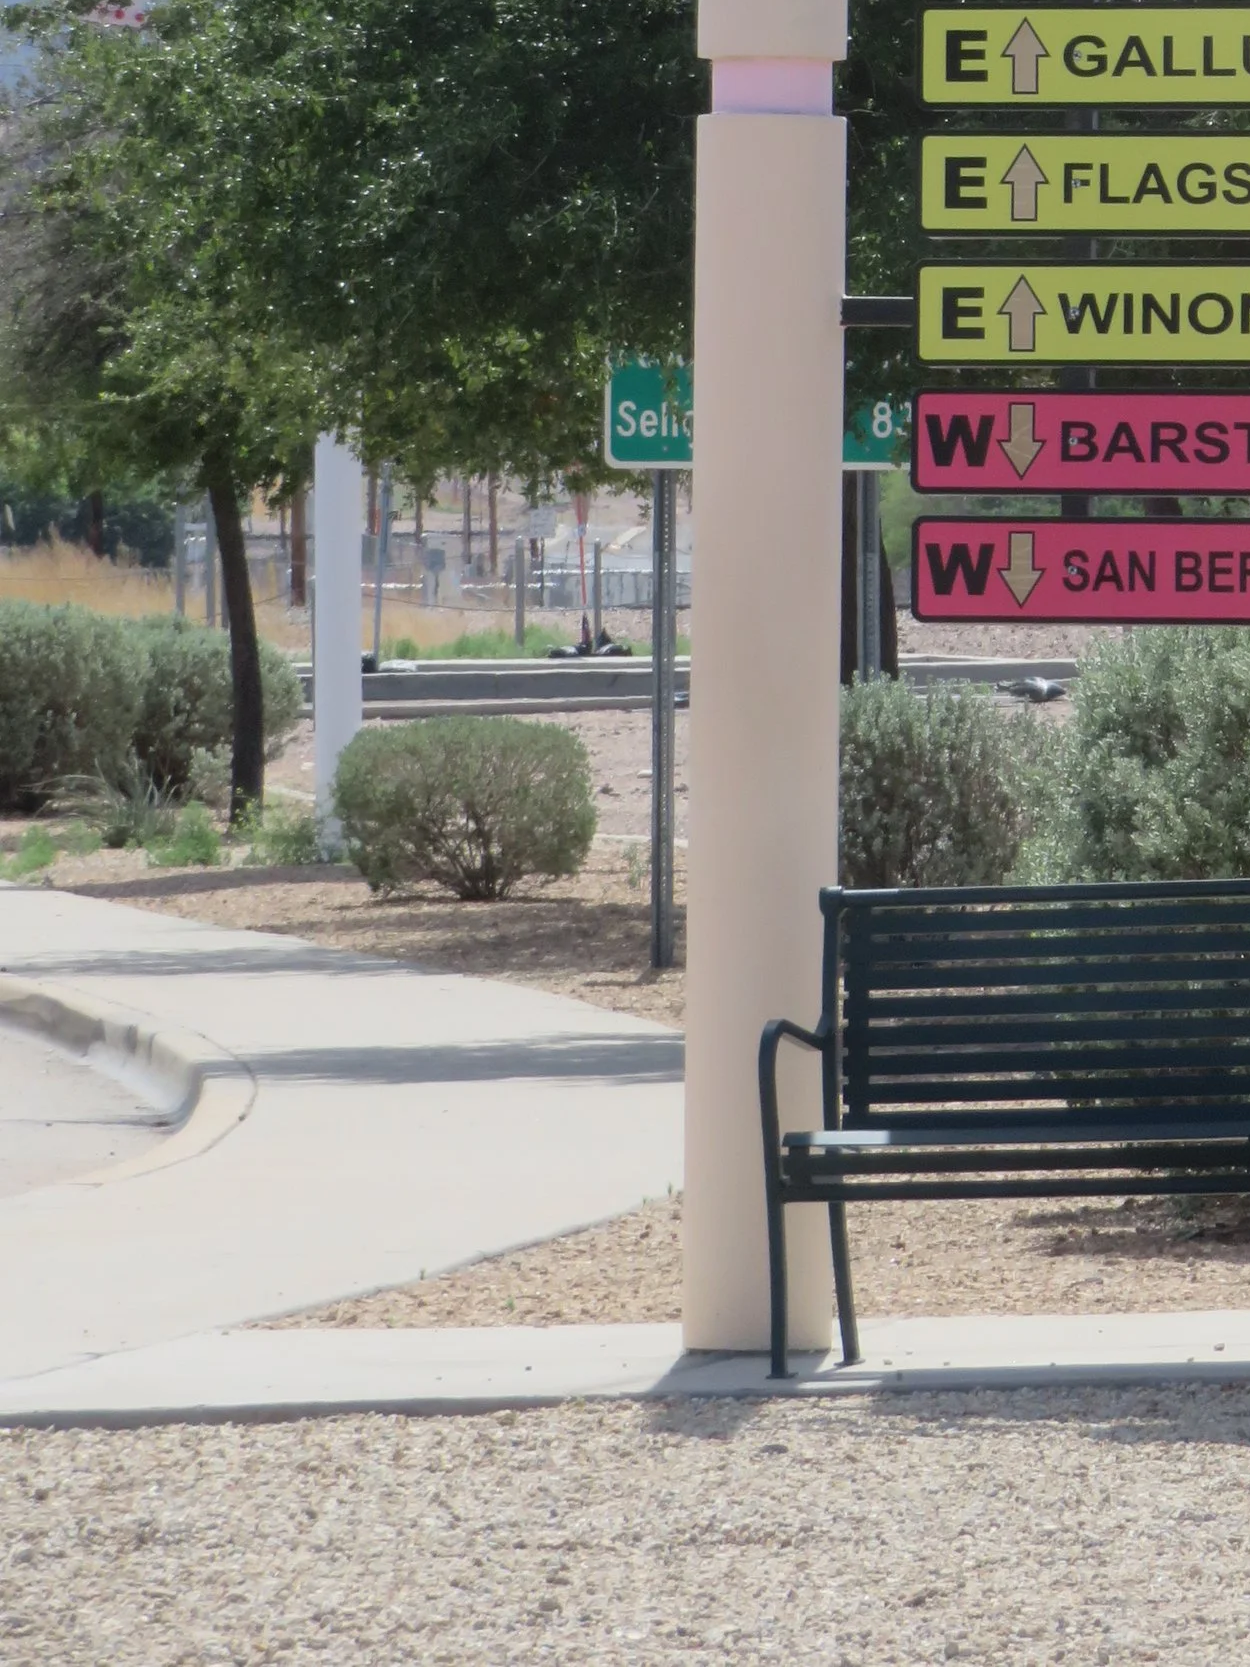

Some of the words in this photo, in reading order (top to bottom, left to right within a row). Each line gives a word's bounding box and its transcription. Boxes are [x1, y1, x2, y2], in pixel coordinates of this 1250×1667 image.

[946, 30, 988, 82] E
[945, 157, 987, 209] E
[942, 287, 985, 339] E
[925, 414, 994, 466] W
[925, 543, 994, 595] W
[1063, 550, 1156, 591] SAN
